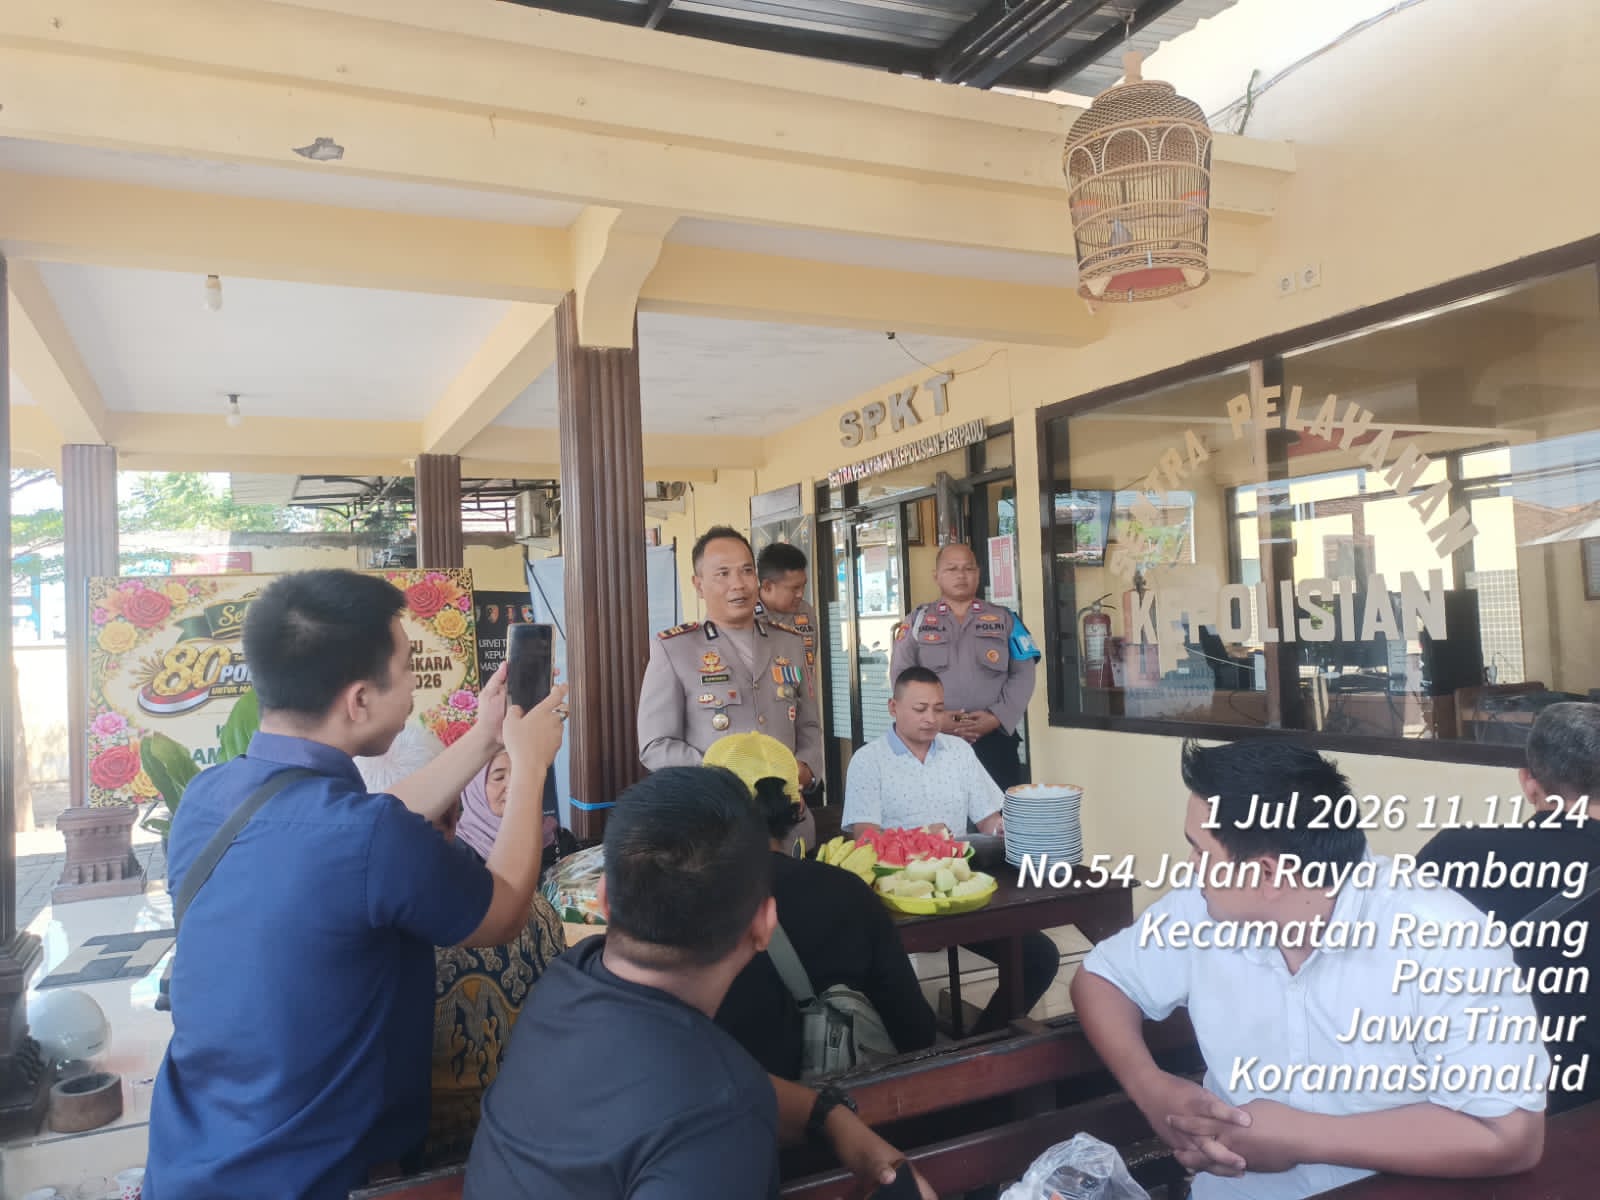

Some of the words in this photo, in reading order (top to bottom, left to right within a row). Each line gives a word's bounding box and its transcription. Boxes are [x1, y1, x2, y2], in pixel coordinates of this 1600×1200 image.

[839, 369, 955, 448] SPKT
[1226, 384, 1480, 559] PELAYANAN
[152, 644, 232, 697] 80
